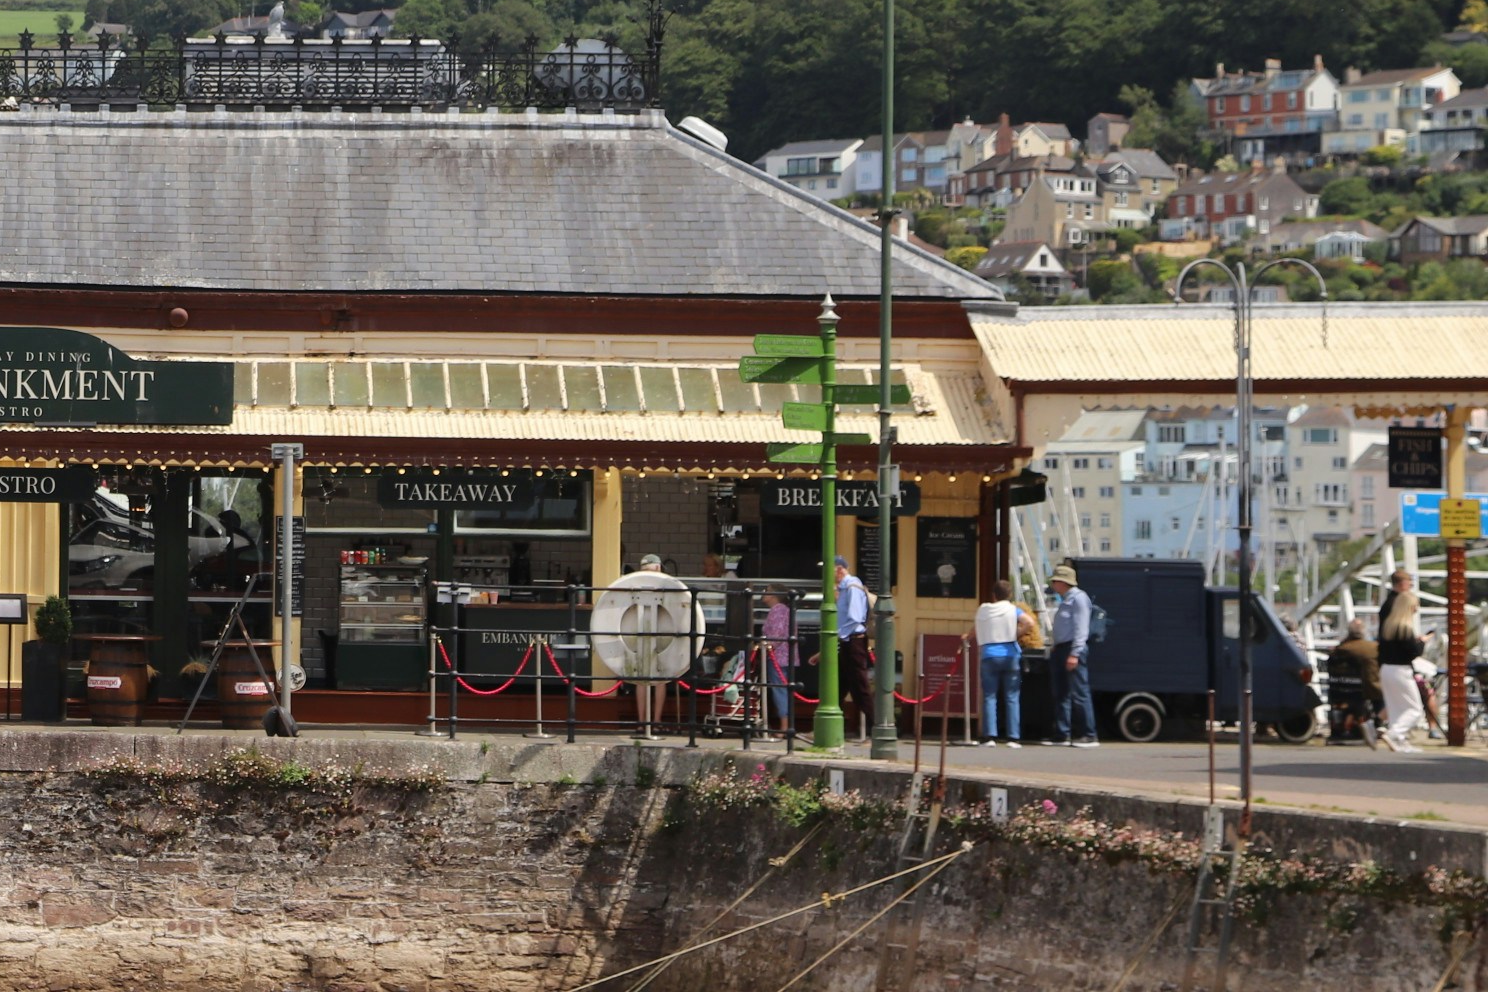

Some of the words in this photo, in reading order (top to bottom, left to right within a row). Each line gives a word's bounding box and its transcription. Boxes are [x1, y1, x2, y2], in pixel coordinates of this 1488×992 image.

[25, 351, 92, 363] DINING
[394, 483, 517, 502] TAKEAWAY
[776, 488, 907, 508] BREKFAT
[482, 633, 562, 644] EMBANK
[996, 796, 1004, 817] 2
